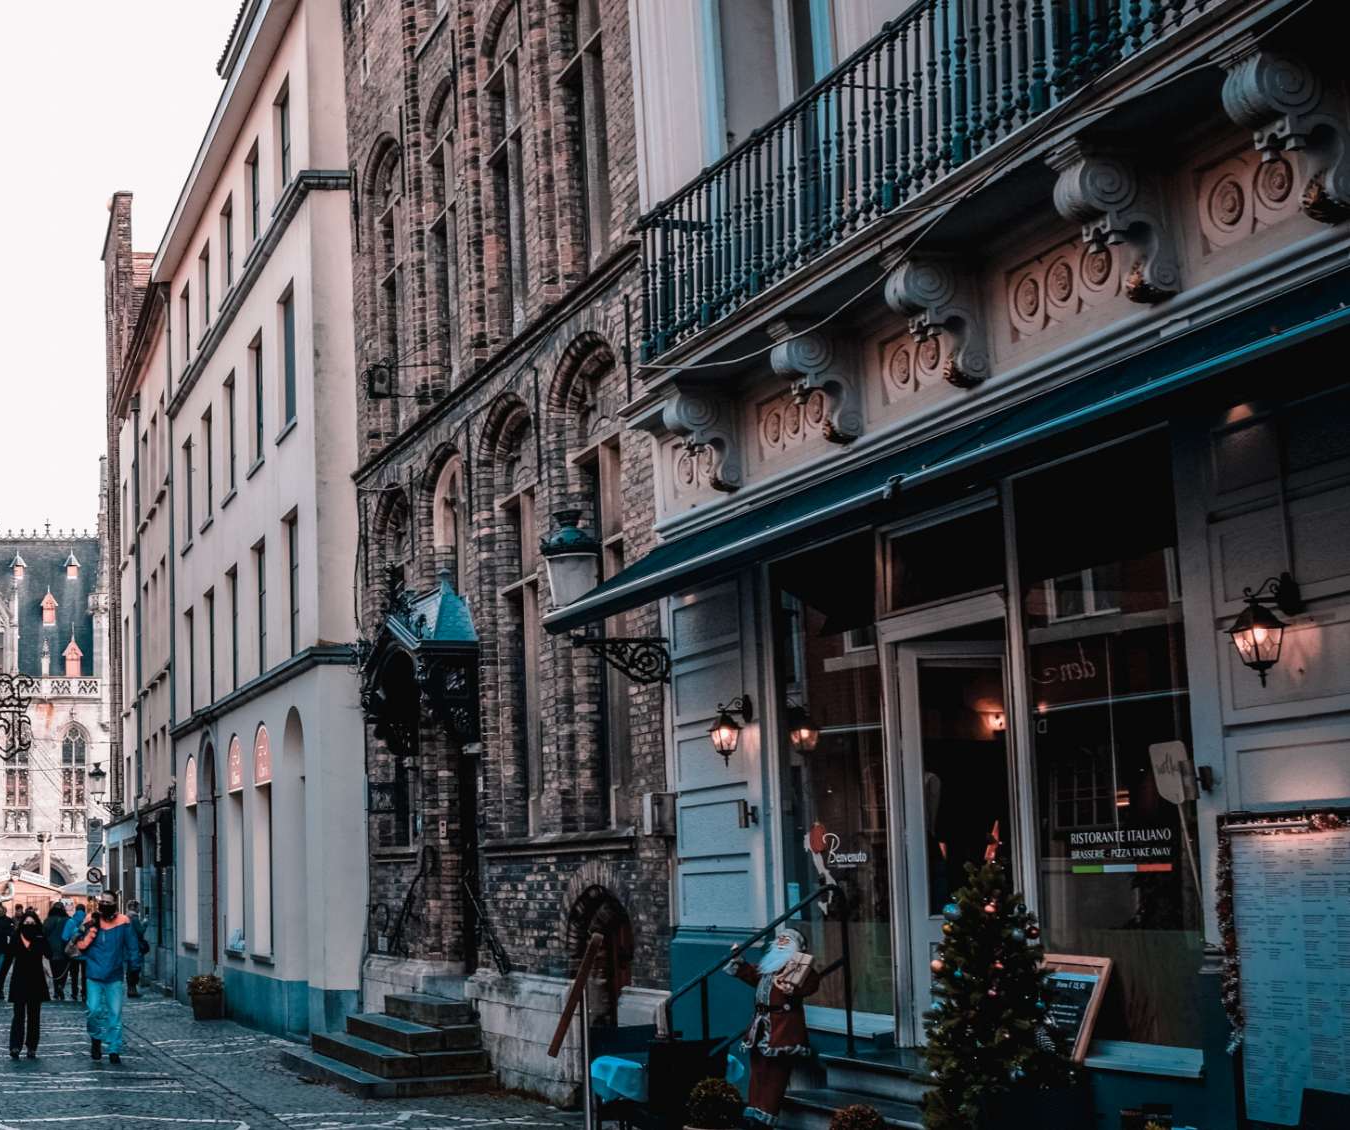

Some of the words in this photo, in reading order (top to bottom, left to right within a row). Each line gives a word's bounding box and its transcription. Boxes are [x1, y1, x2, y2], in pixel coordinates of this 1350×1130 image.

[1070, 830, 1125, 845] RISTORANTE
[1127, 827, 1172, 842] ITALIANO
[822, 833, 867, 864] Benvenuto
[1071, 849, 1105, 860] BRASSERIE
[1111, 848, 1131, 858] PIZZA
[1132, 848, 1149, 858] TAKE
[1151, 847, 1171, 857] AWAY
